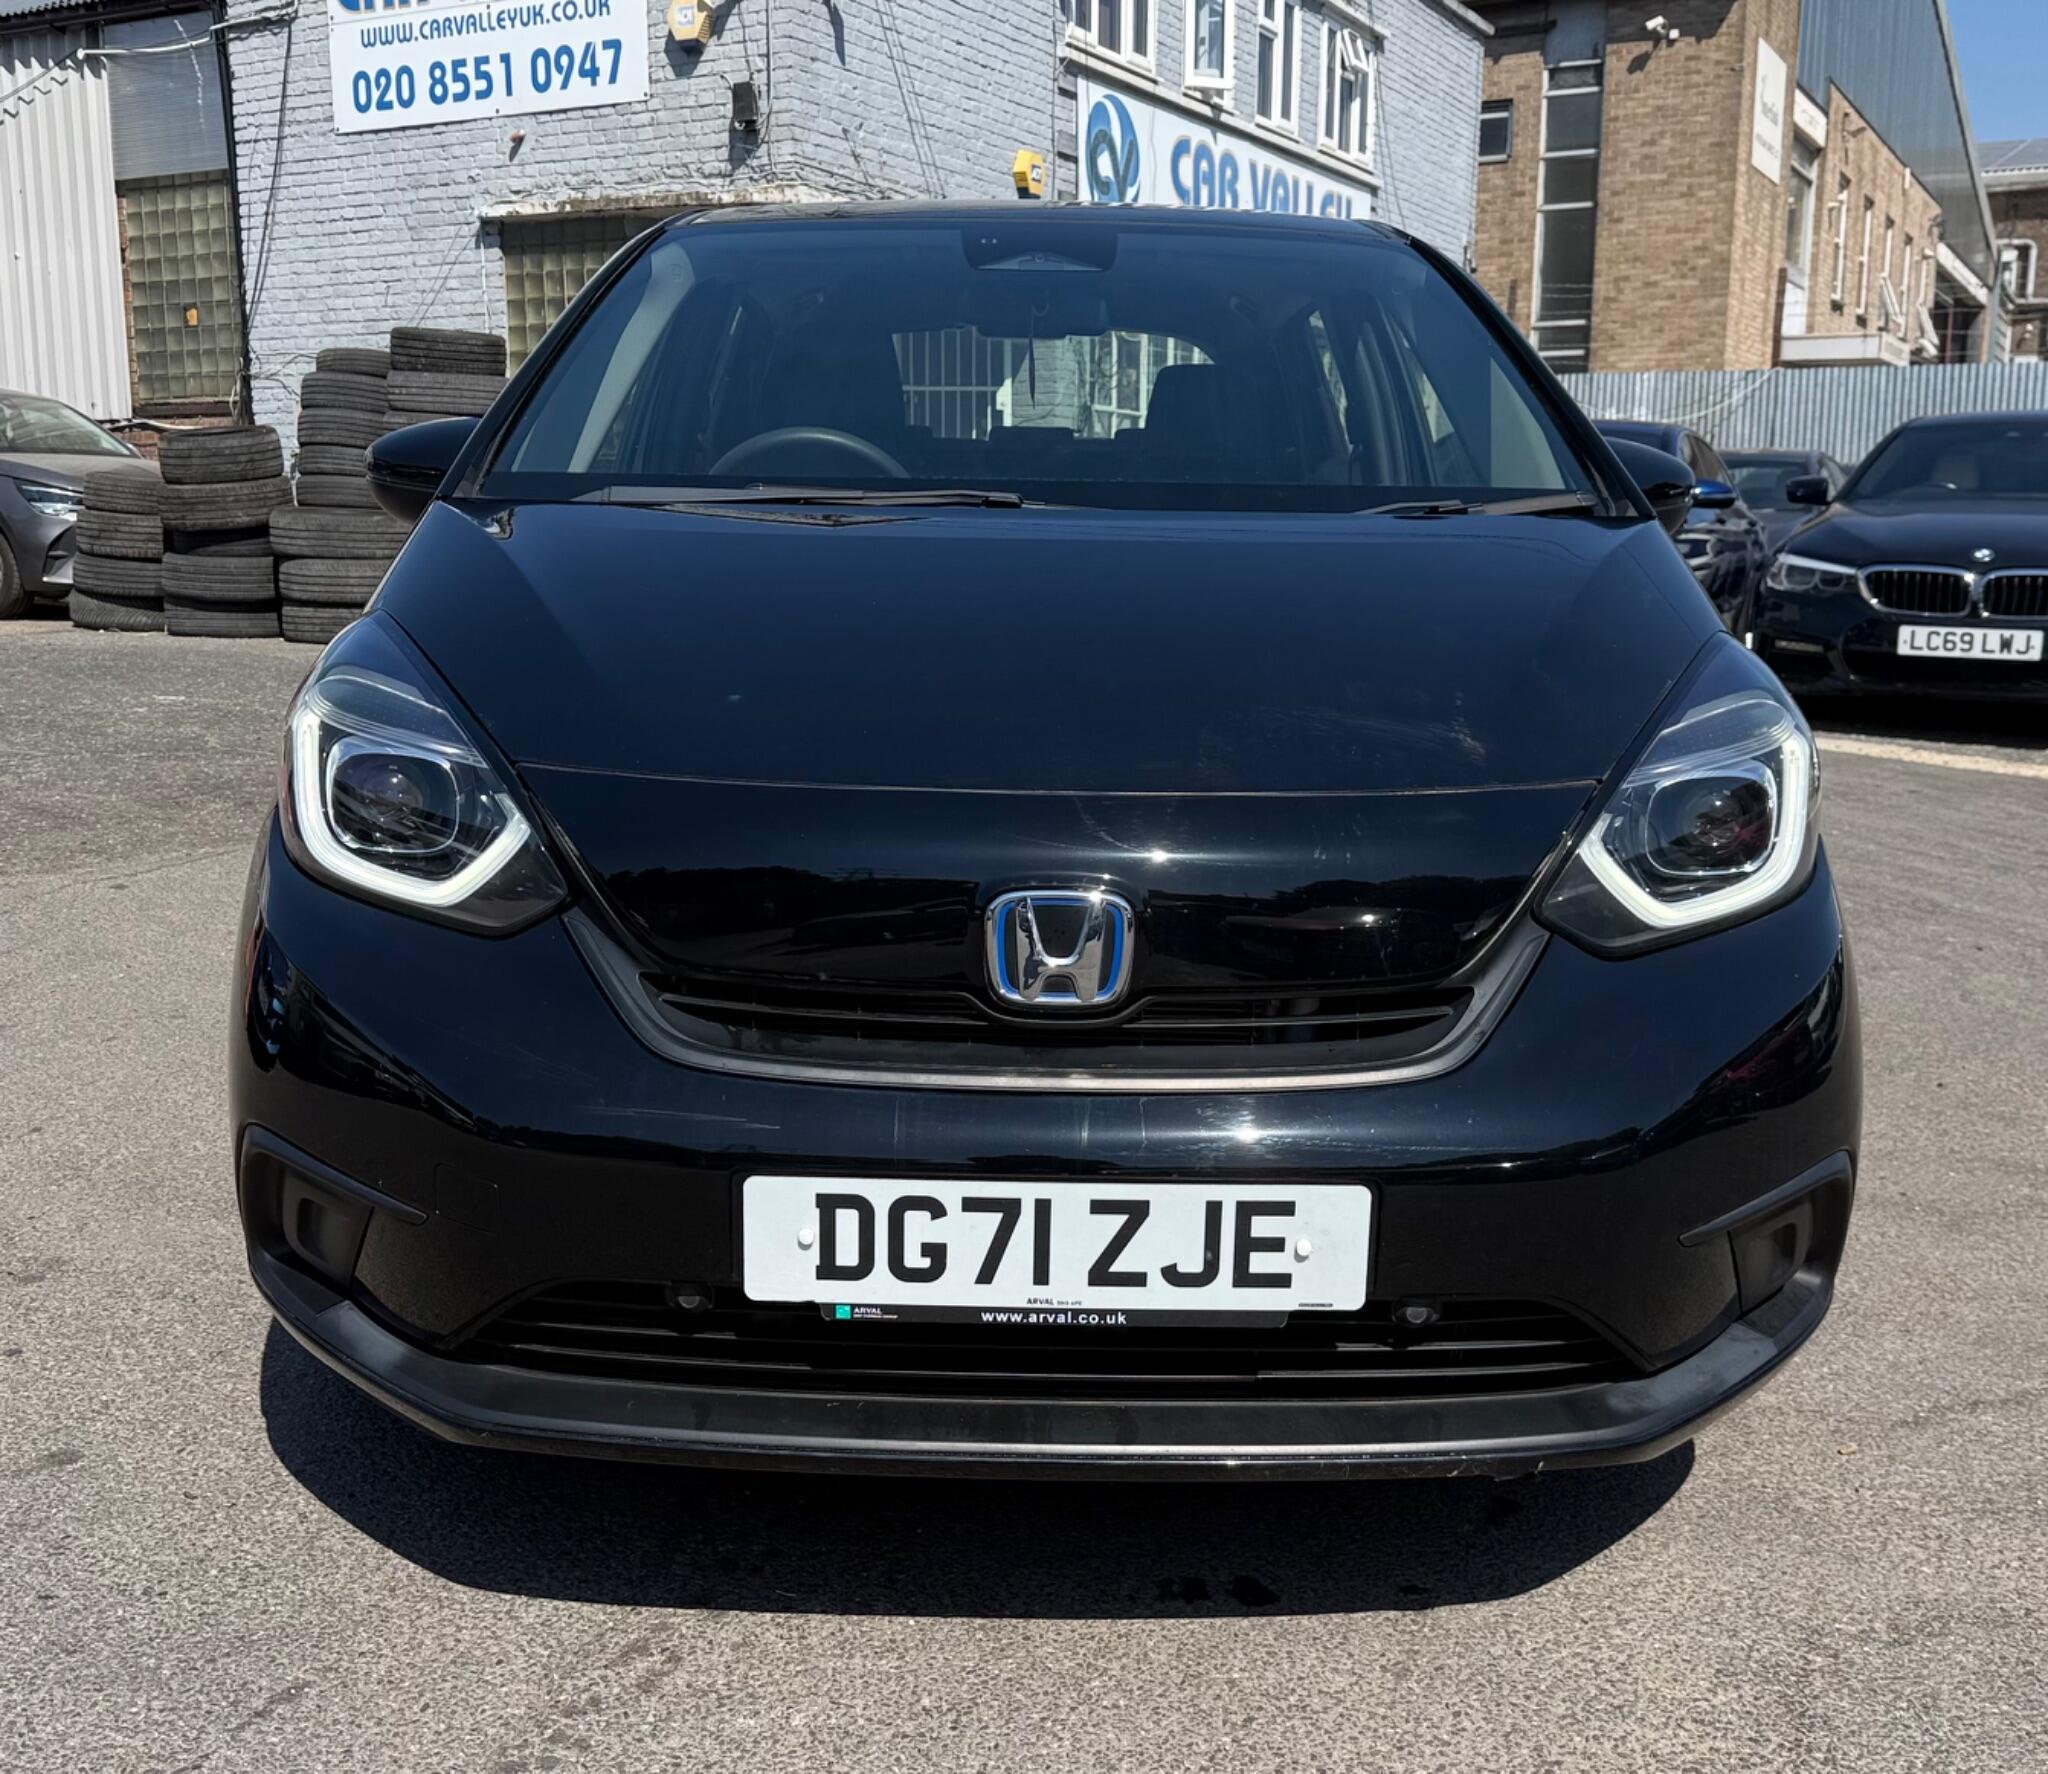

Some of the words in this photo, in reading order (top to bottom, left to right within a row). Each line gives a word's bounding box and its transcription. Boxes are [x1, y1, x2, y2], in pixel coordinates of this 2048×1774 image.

[352, 65, 416, 113] 020
[428, 53, 513, 105] 8551
[530, 38, 622, 93] 0947
[1170, 135, 1239, 208] CAR
[1909, 629, 1974, 652] LC69
[1981, 632, 2032, 655] LWJ
[815, 1192, 1052, 1286] DG71
[1087, 1199, 1297, 1288] ZJE
[981, 1311, 1127, 1324] www.arval.co.uk
[1026, 1297, 1054, 1305] ARVAL
